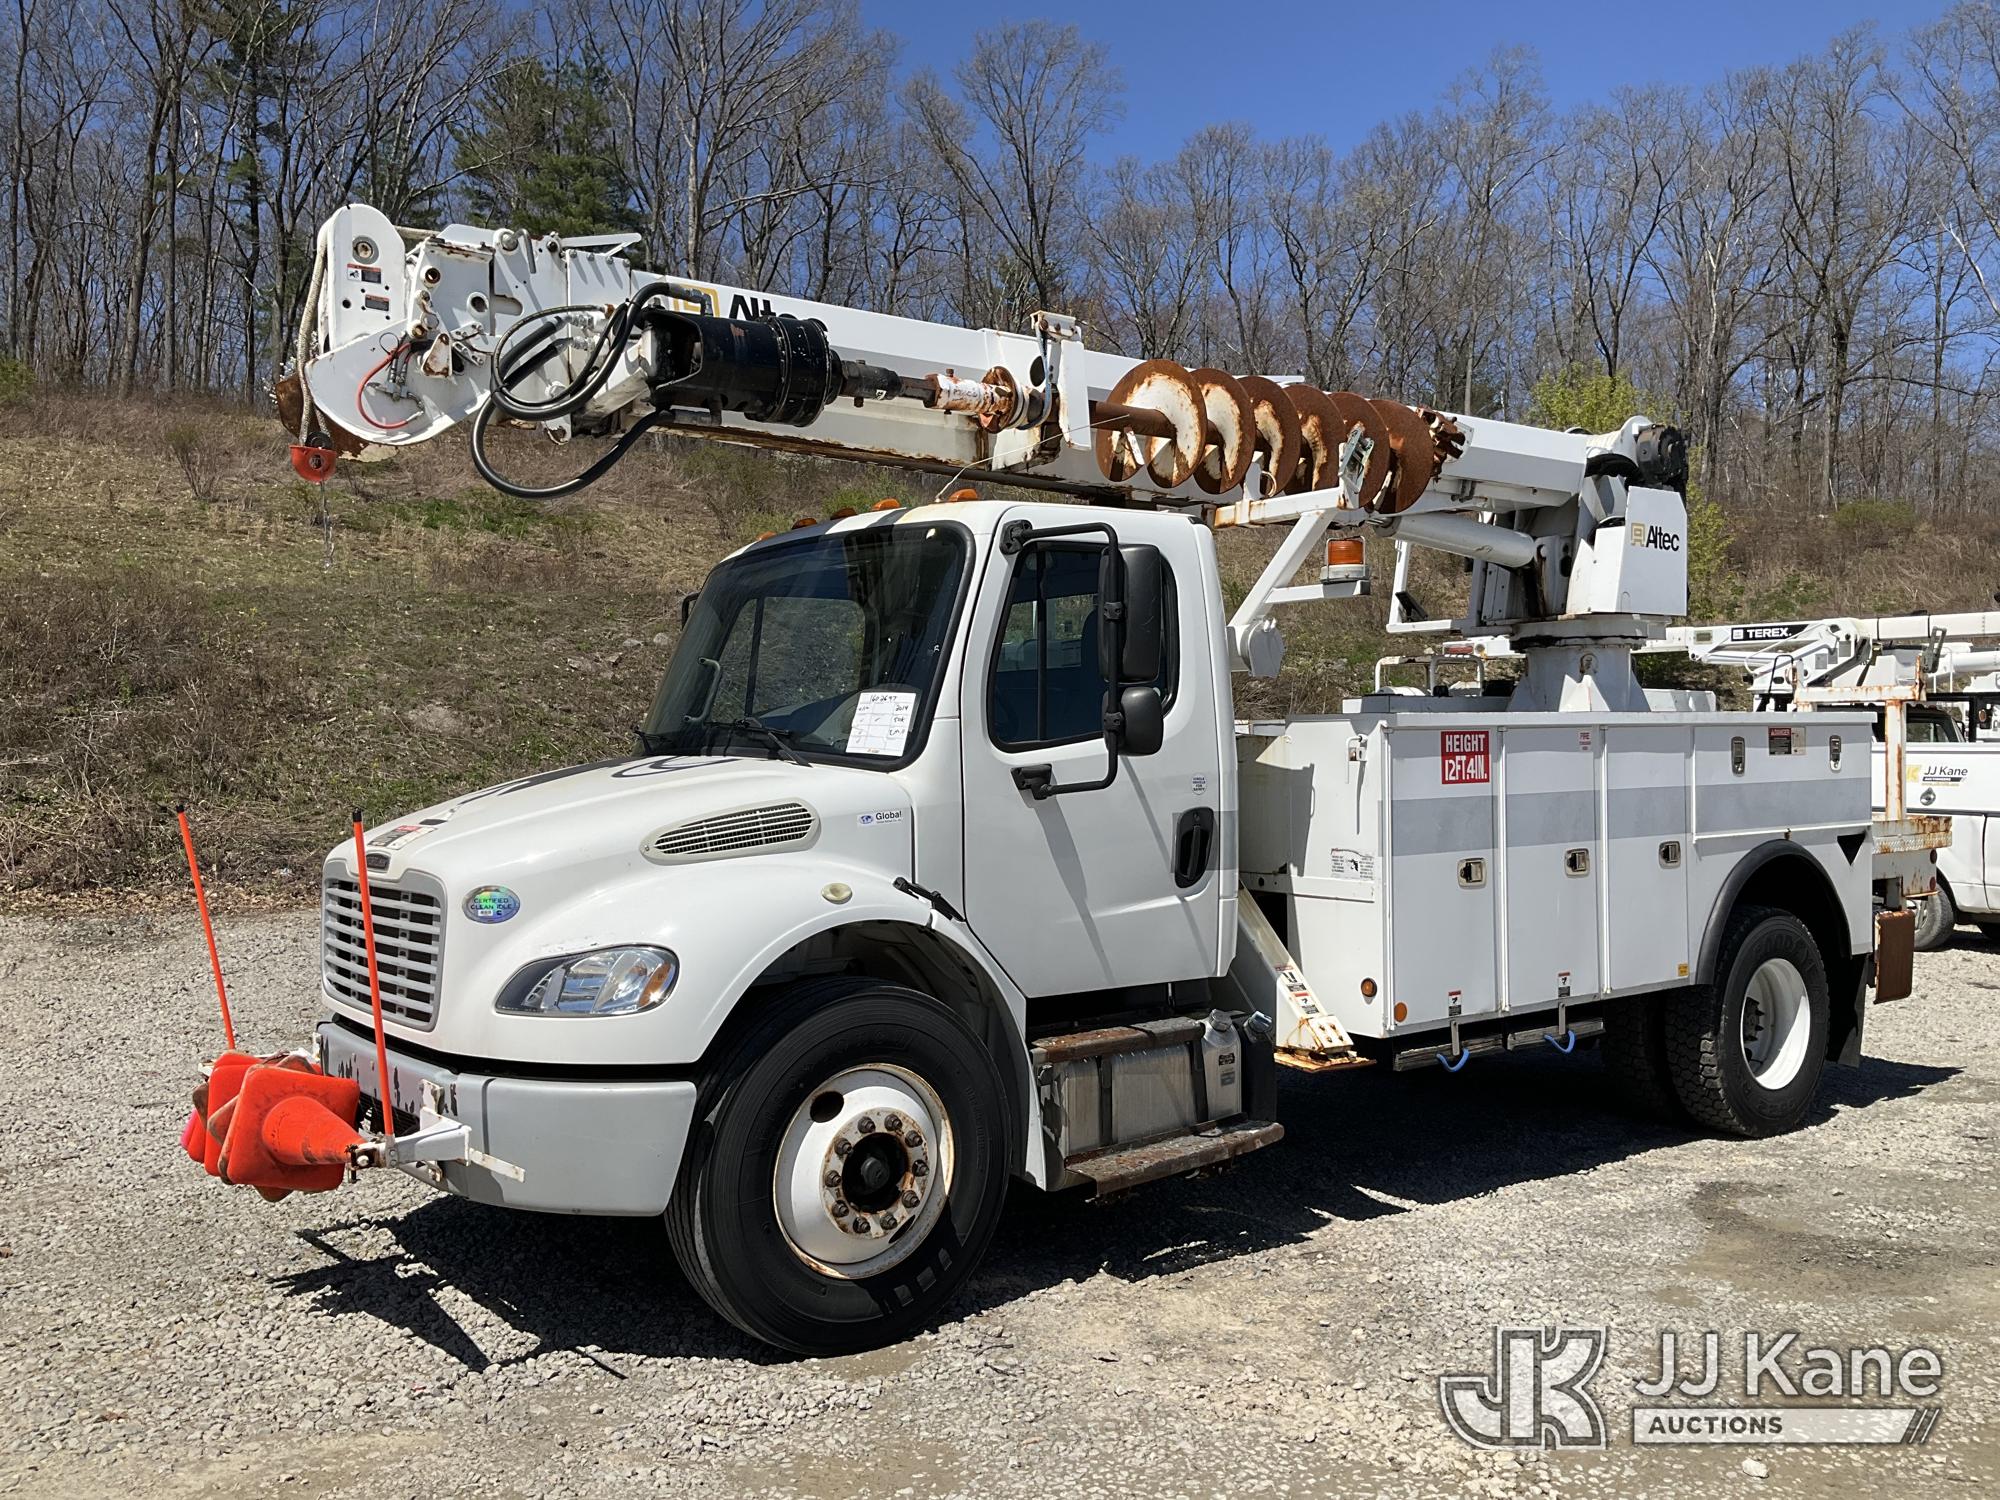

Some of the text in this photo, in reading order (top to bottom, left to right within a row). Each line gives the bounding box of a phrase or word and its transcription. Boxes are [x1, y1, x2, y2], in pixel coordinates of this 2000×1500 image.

[1646, 525, 1680, 552] Altec
[1445, 734, 1486, 753] HEIGHT
[1924, 766, 1937, 776] JJ
[1940, 766, 1968, 776] Kane
[875, 811, 902, 820] Global
